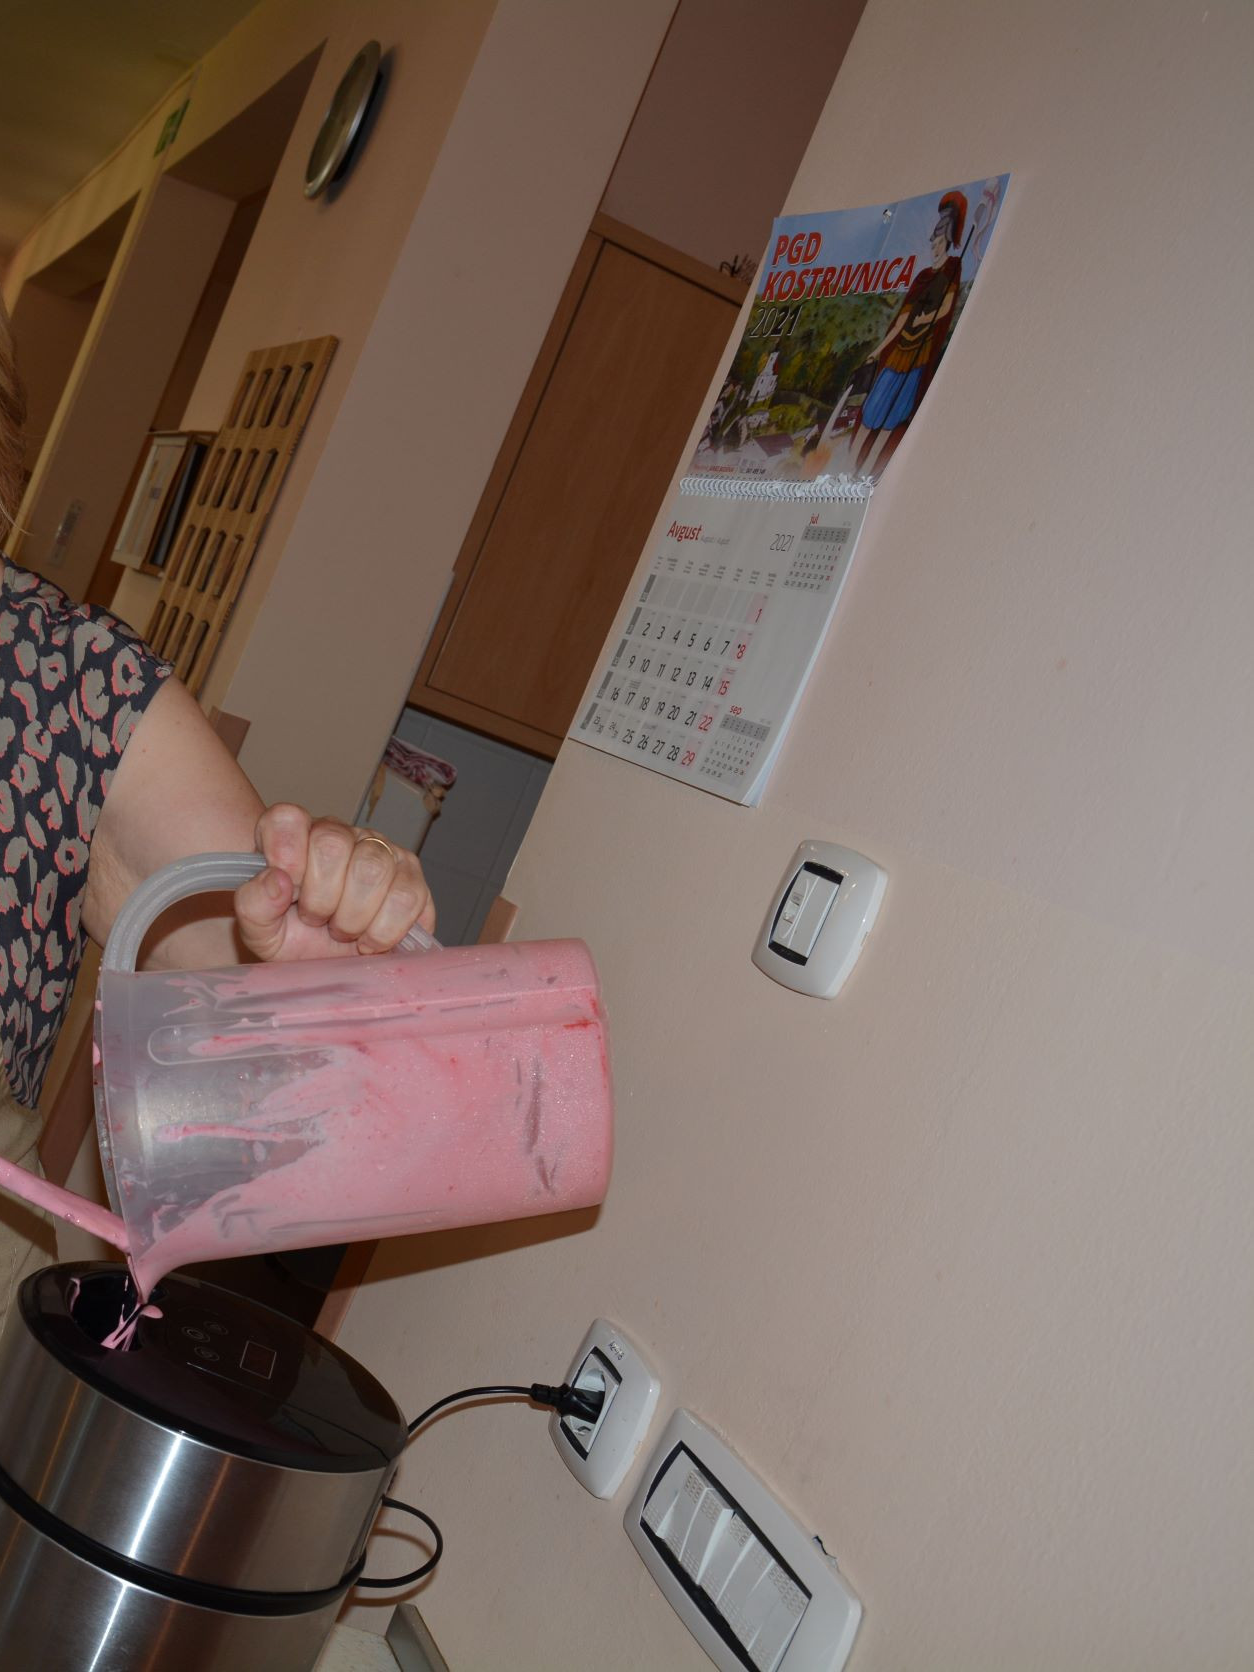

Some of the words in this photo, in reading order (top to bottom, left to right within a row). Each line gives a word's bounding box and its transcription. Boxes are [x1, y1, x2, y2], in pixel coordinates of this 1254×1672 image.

[772, 232, 824, 267] PGD
[761, 255, 918, 303] KOSTRIVNICA
[749, 305, 803, 338] 2021
[666, 520, 703, 542] Avgust
[809, 513, 820, 527] jul
[769, 533, 795, 552] 2021
[754, 608, 763, 623] 1
[642, 622, 651, 636] 2
[656, 626, 666, 640] 3
[673, 630, 681, 644] 4
[687, 633, 696, 647] 5
[703, 637, 712, 651] 6
[720, 640, 730, 655] 7
[736, 644, 746, 659] 8
[627, 655, 636, 668] 9
[640, 659, 651, 673] 10
[656, 663, 666, 677] 11
[670, 667, 681, 682] 12
[685, 671, 697, 686] 13
[702, 676, 713, 691] 14
[718, 680, 730, 696] 15
[610, 687, 620, 700] 16
[625, 692, 636, 705] 17
[640, 697, 650, 711] 18
[655, 701, 666, 715] 19
[667, 705, 680, 720] 20
[684, 710, 697, 726] 21
[698, 715, 713, 731] 22
[730, 705, 743, 718] sep
[622, 729, 635, 744] 25
[637, 734, 650, 750] 26
[652, 740, 666, 755] 27
[667, 745, 680, 761] 28
[681, 750, 696, 766] 29
